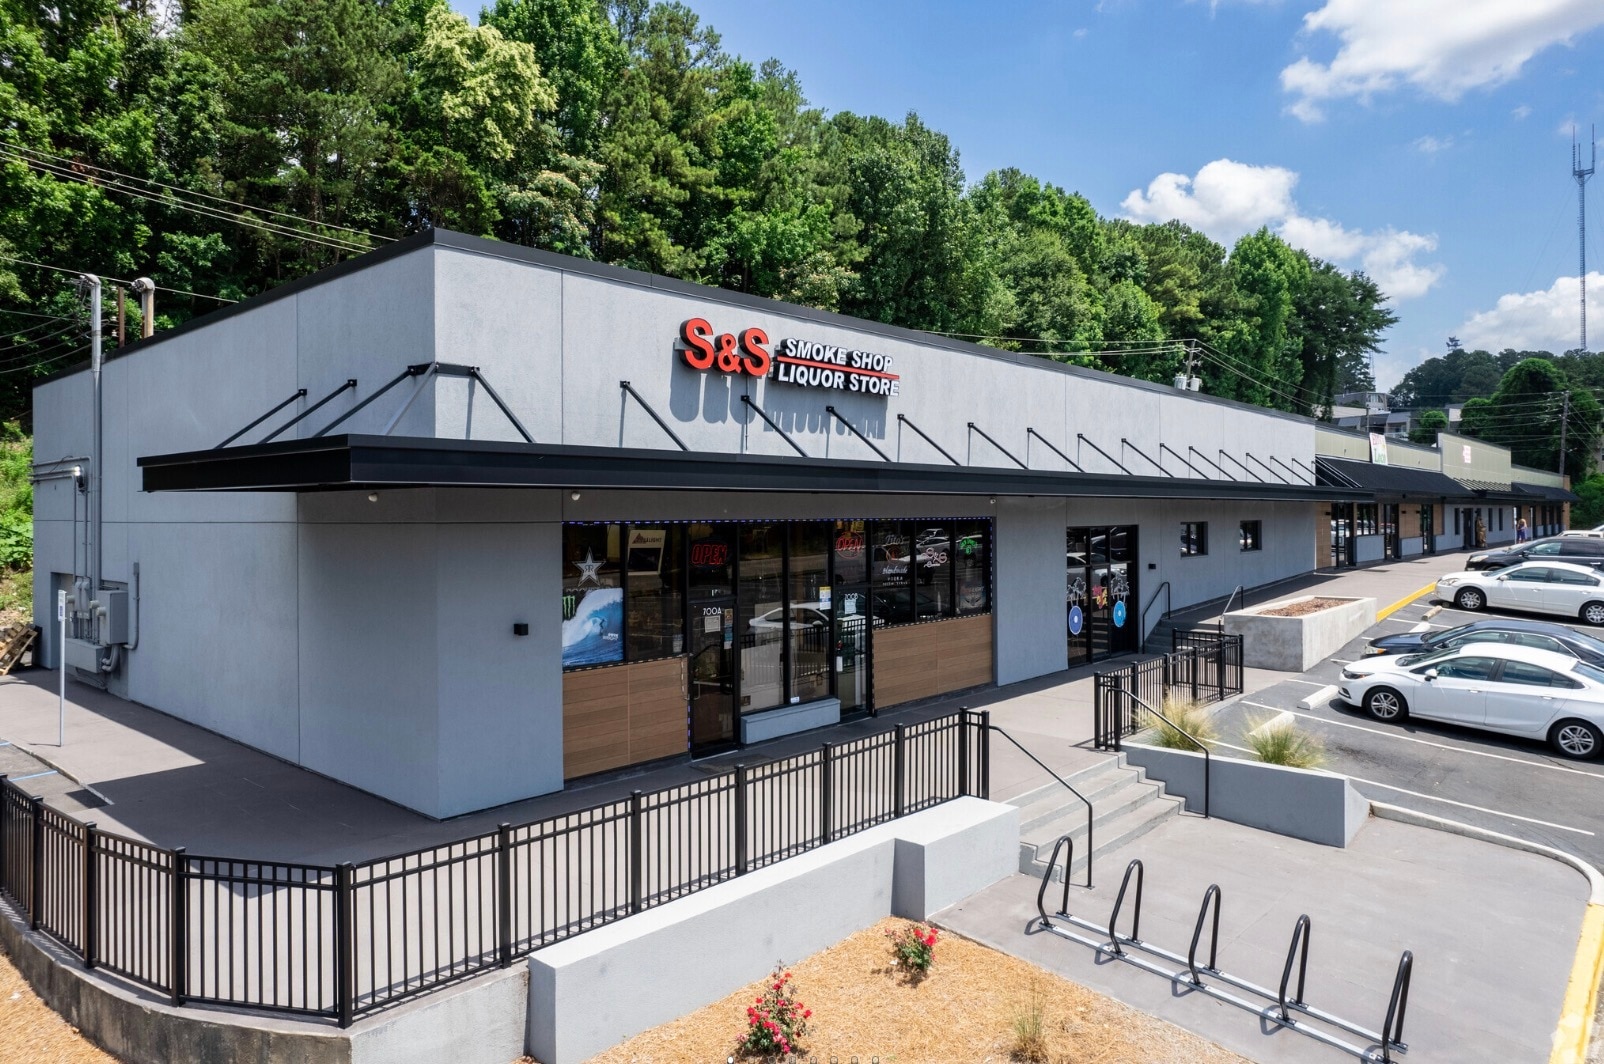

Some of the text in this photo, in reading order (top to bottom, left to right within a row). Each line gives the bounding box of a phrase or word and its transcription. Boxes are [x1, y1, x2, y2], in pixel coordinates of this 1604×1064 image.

[681, 318, 771, 376] S&S
[784, 339, 893, 372] SMOKE SHOP
[778, 363, 900, 396] LIQUOR STORE
[692, 544, 728, 565] OPEN
